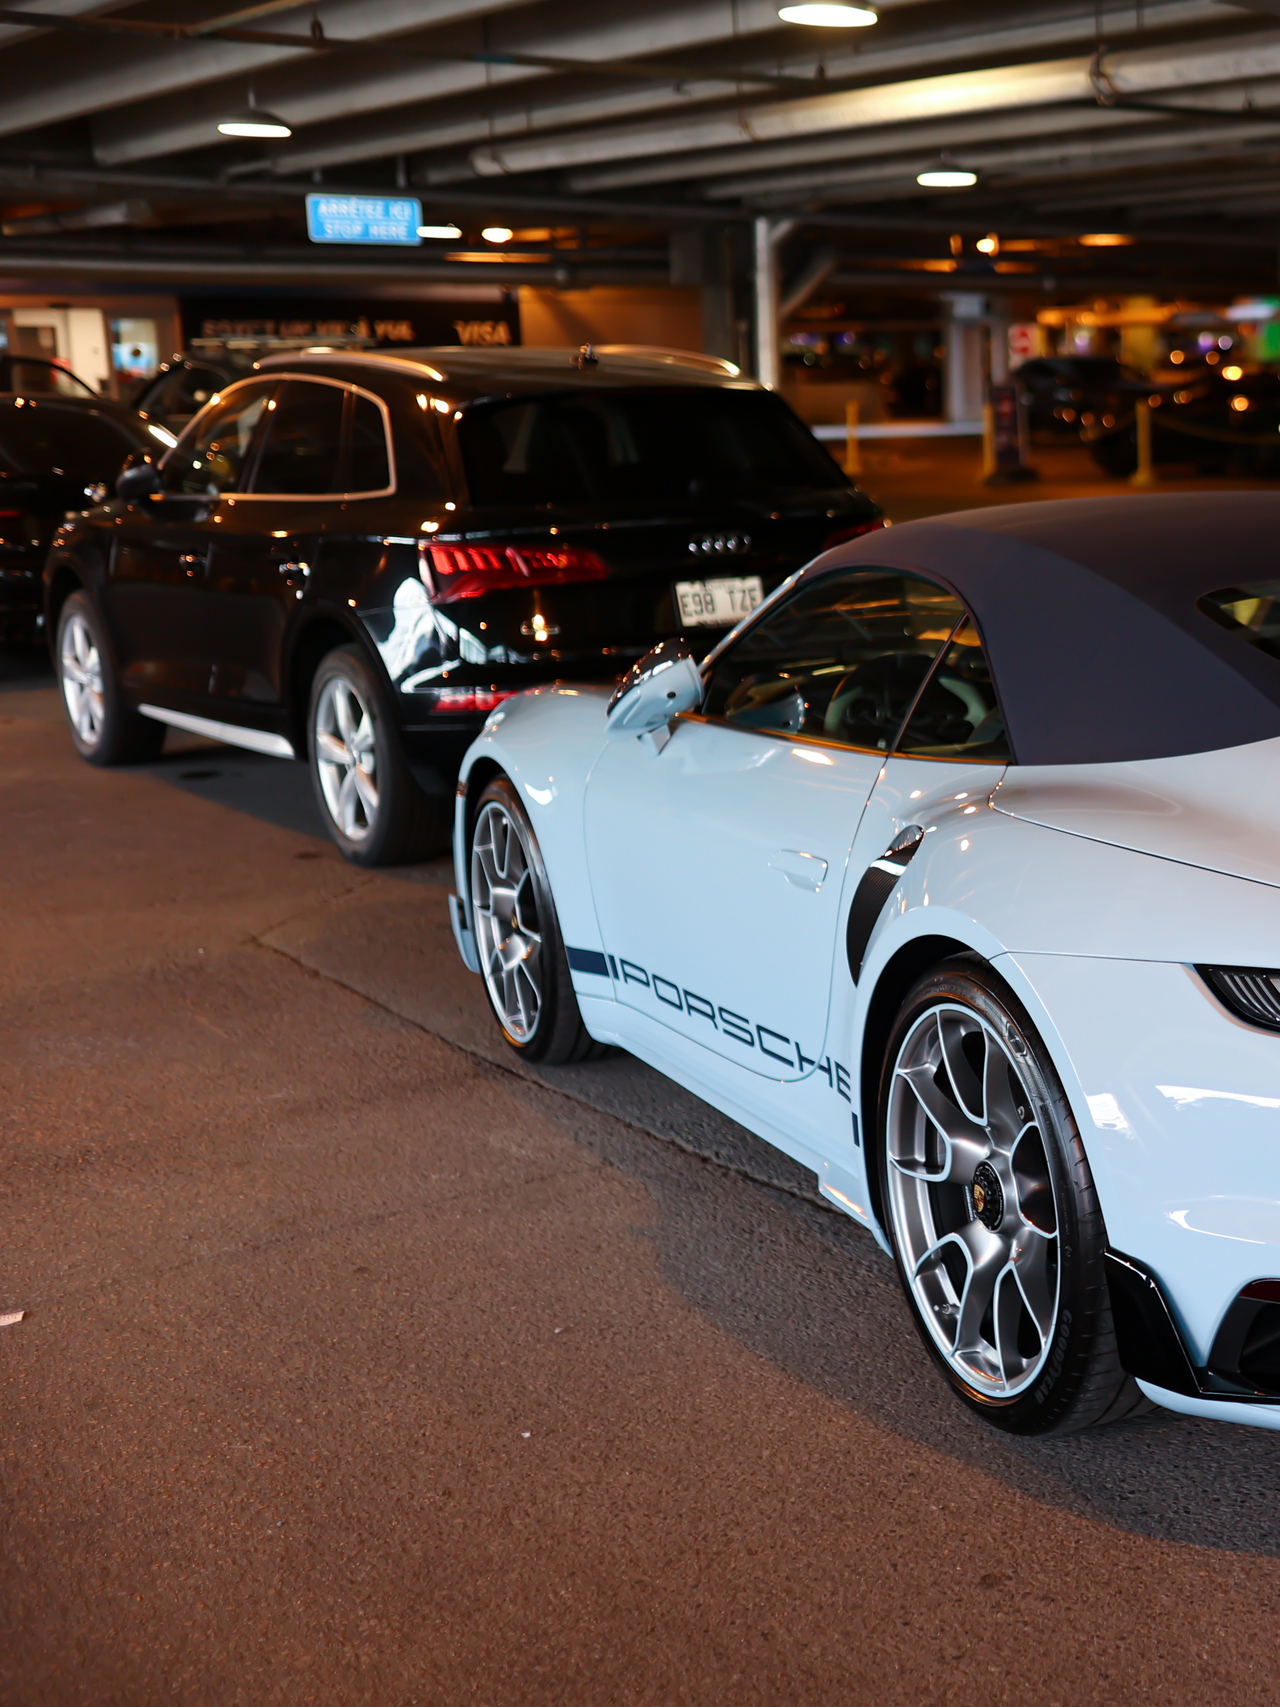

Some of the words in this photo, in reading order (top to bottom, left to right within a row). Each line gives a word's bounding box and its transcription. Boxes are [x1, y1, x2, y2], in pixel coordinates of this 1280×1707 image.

[388, 200, 412, 220] ICI
[324, 219, 363, 239] STOP
[367, 221, 409, 241] HERE
[454, 319, 512, 346] VISA
[680, 591, 715, 617] E98
[620, 957, 852, 1105] PORSCHE
[1034, 1309, 1073, 1404] GOODYEAR
